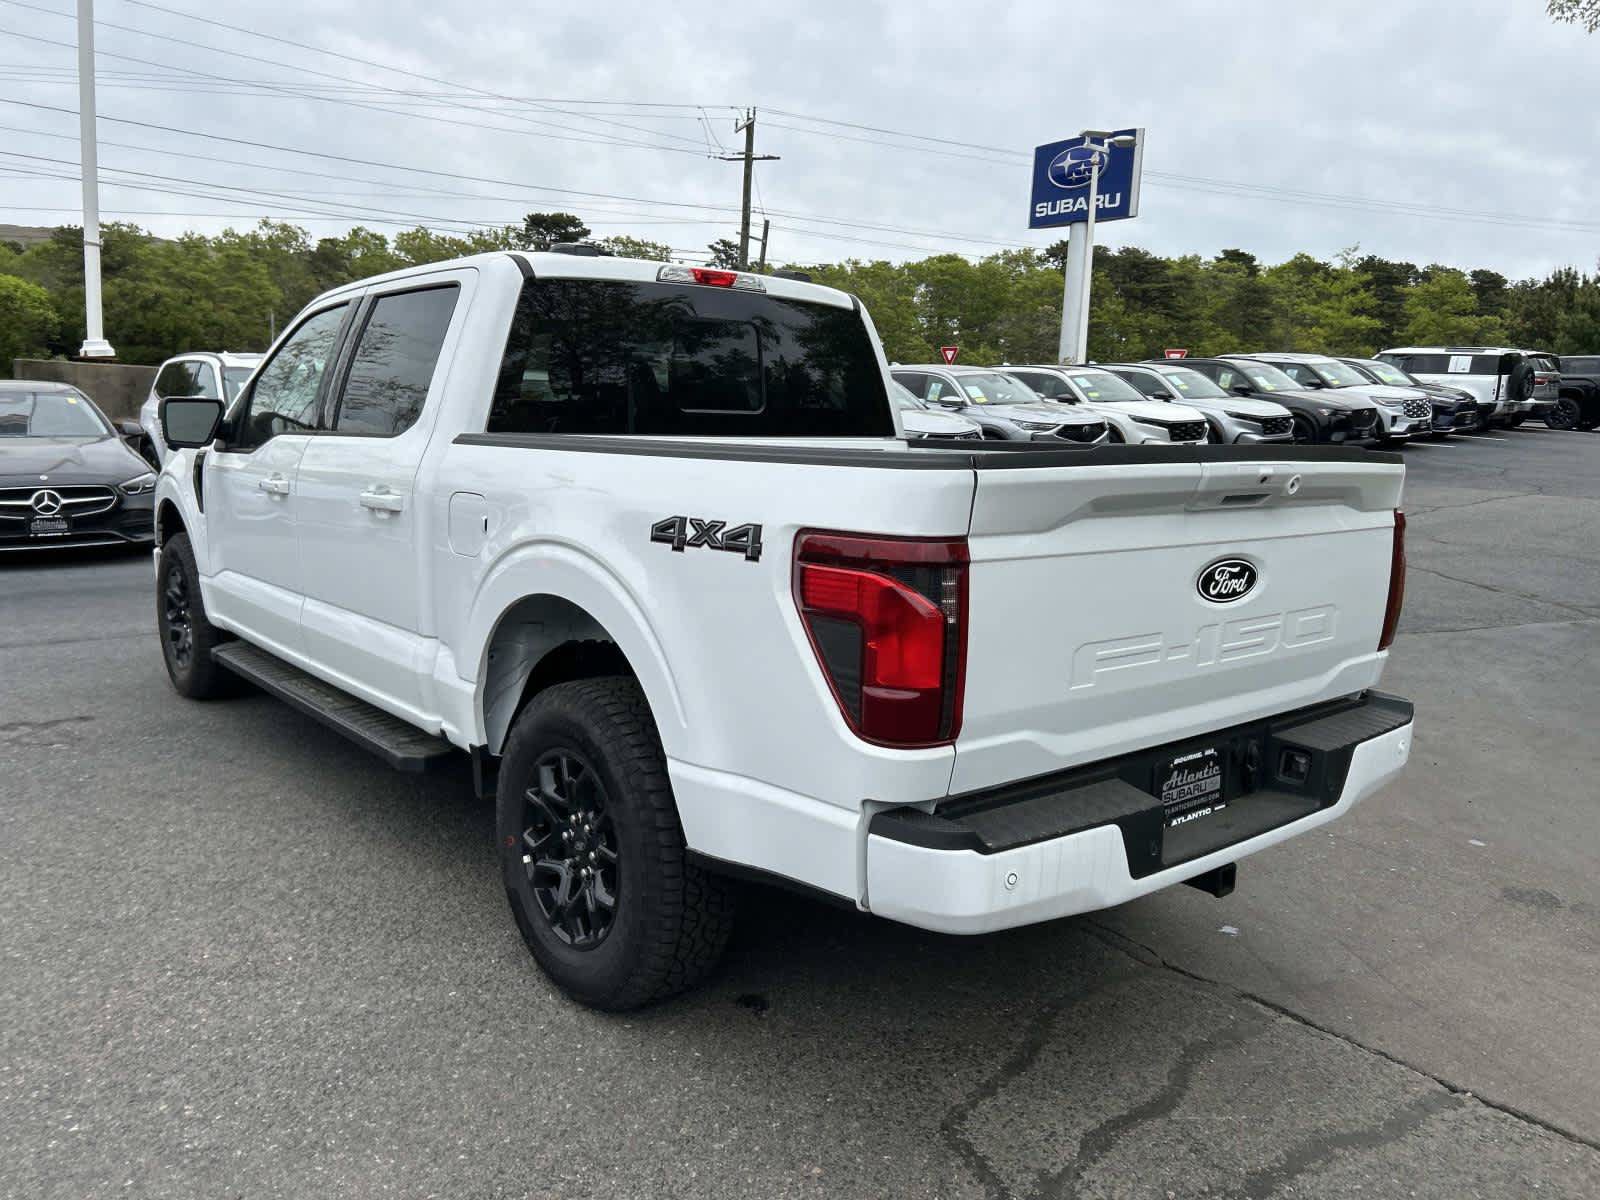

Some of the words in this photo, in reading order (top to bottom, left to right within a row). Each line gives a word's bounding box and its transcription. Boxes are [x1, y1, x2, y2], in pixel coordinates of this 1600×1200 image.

[1035, 192, 1121, 218] SUBARU
[1210, 566, 1249, 595] Ford
[1069, 603, 1337, 690] F-150
[1162, 765, 1221, 792] Atlantic
[1163, 781, 1208, 803] SUBARU
